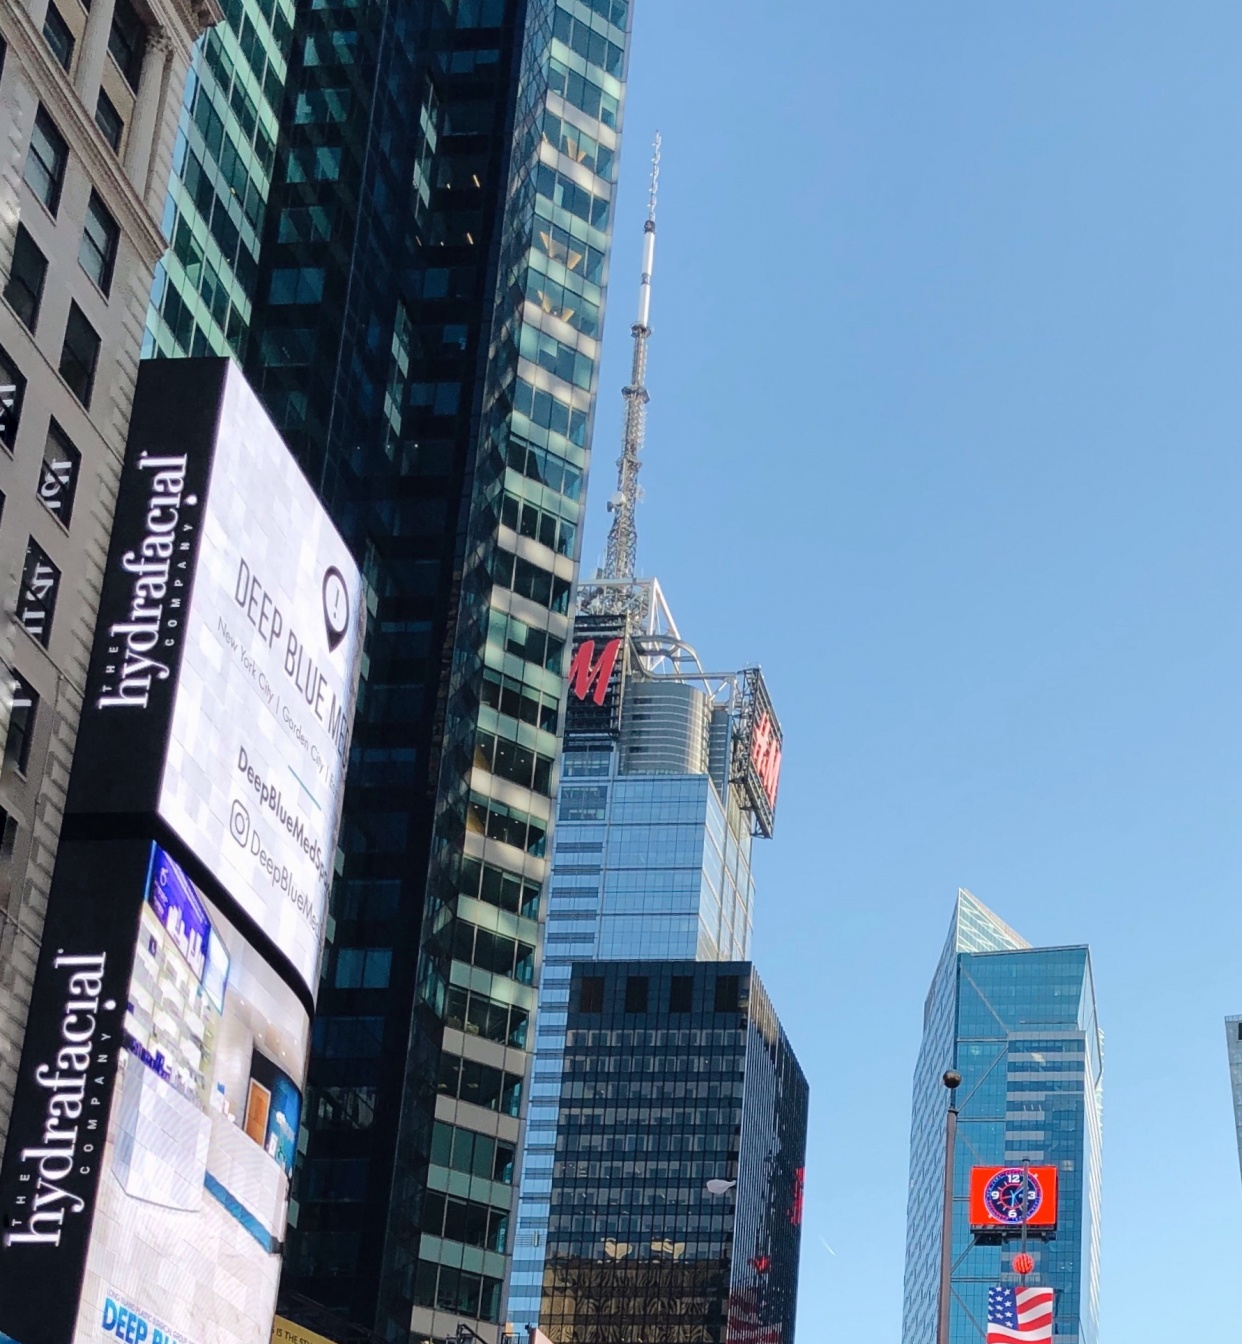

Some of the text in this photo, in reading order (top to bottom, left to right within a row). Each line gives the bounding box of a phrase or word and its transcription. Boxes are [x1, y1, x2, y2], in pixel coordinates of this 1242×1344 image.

[98, 451, 188, 709] hydrafacial
[164, 524, 194, 647] COMPANY
[235, 556, 283, 649] DEEP
[284, 628, 328, 721] BLUE
[103, 646, 118, 692] THE
[218, 616, 324, 774] New York City Garden City
[6, 951, 108, 1247] hydrafacial
[80, 1033, 112, 1174] COMPANY
[12, 1174, 30, 1226] THE
[991, 1191, 1000, 1200] 9
[1007, 1174, 1020, 1184] 12
[1027, 1191, 1037, 1200] 3
[1008, 1209, 1018, 1218] 6
[276, 1328, 283, 1338] IS
[284, 1331, 297, 1344] THE
